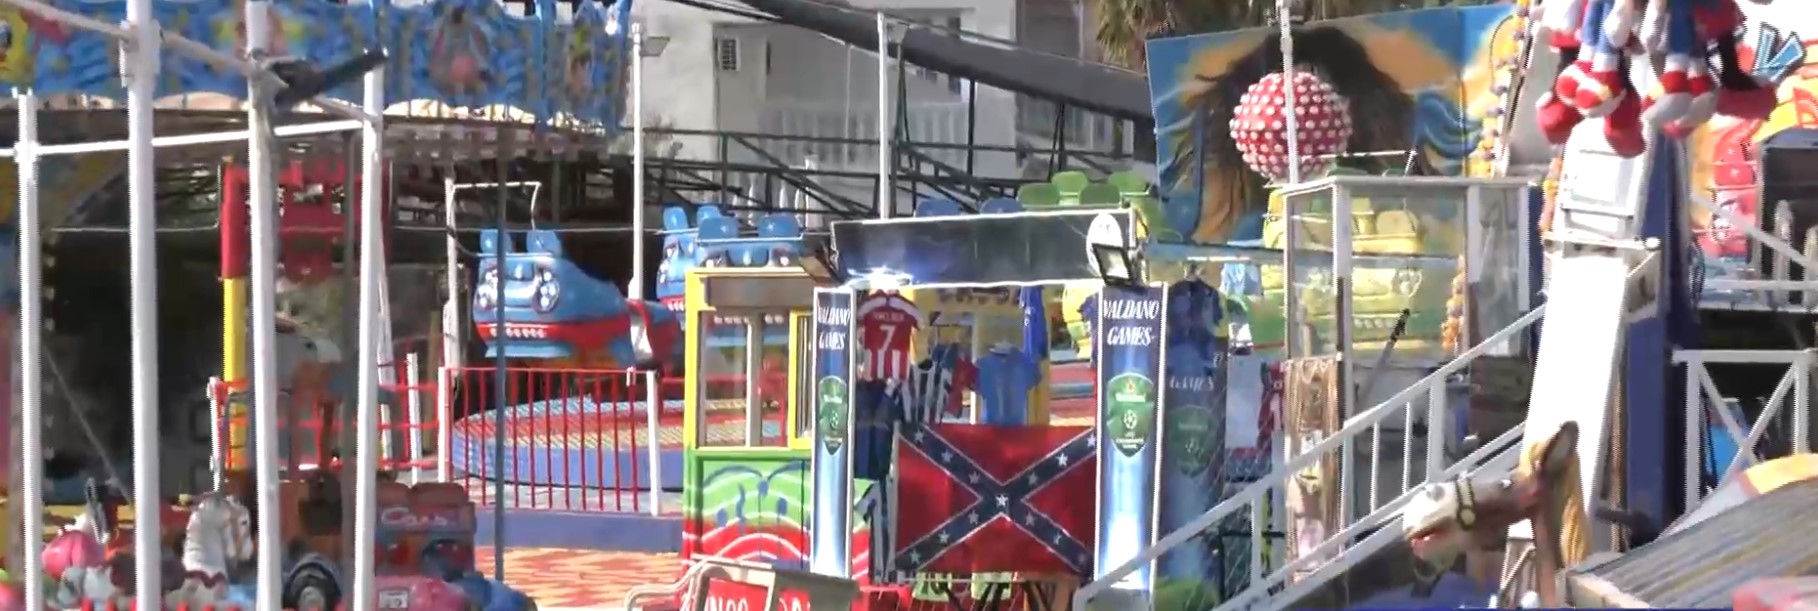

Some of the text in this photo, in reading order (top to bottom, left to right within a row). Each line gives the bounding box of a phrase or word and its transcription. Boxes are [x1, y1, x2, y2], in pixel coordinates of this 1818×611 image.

[1102, 299, 1159, 320] VALDANO
[880, 324, 896, 351] 7
[1107, 325, 1152, 346] GAMES
